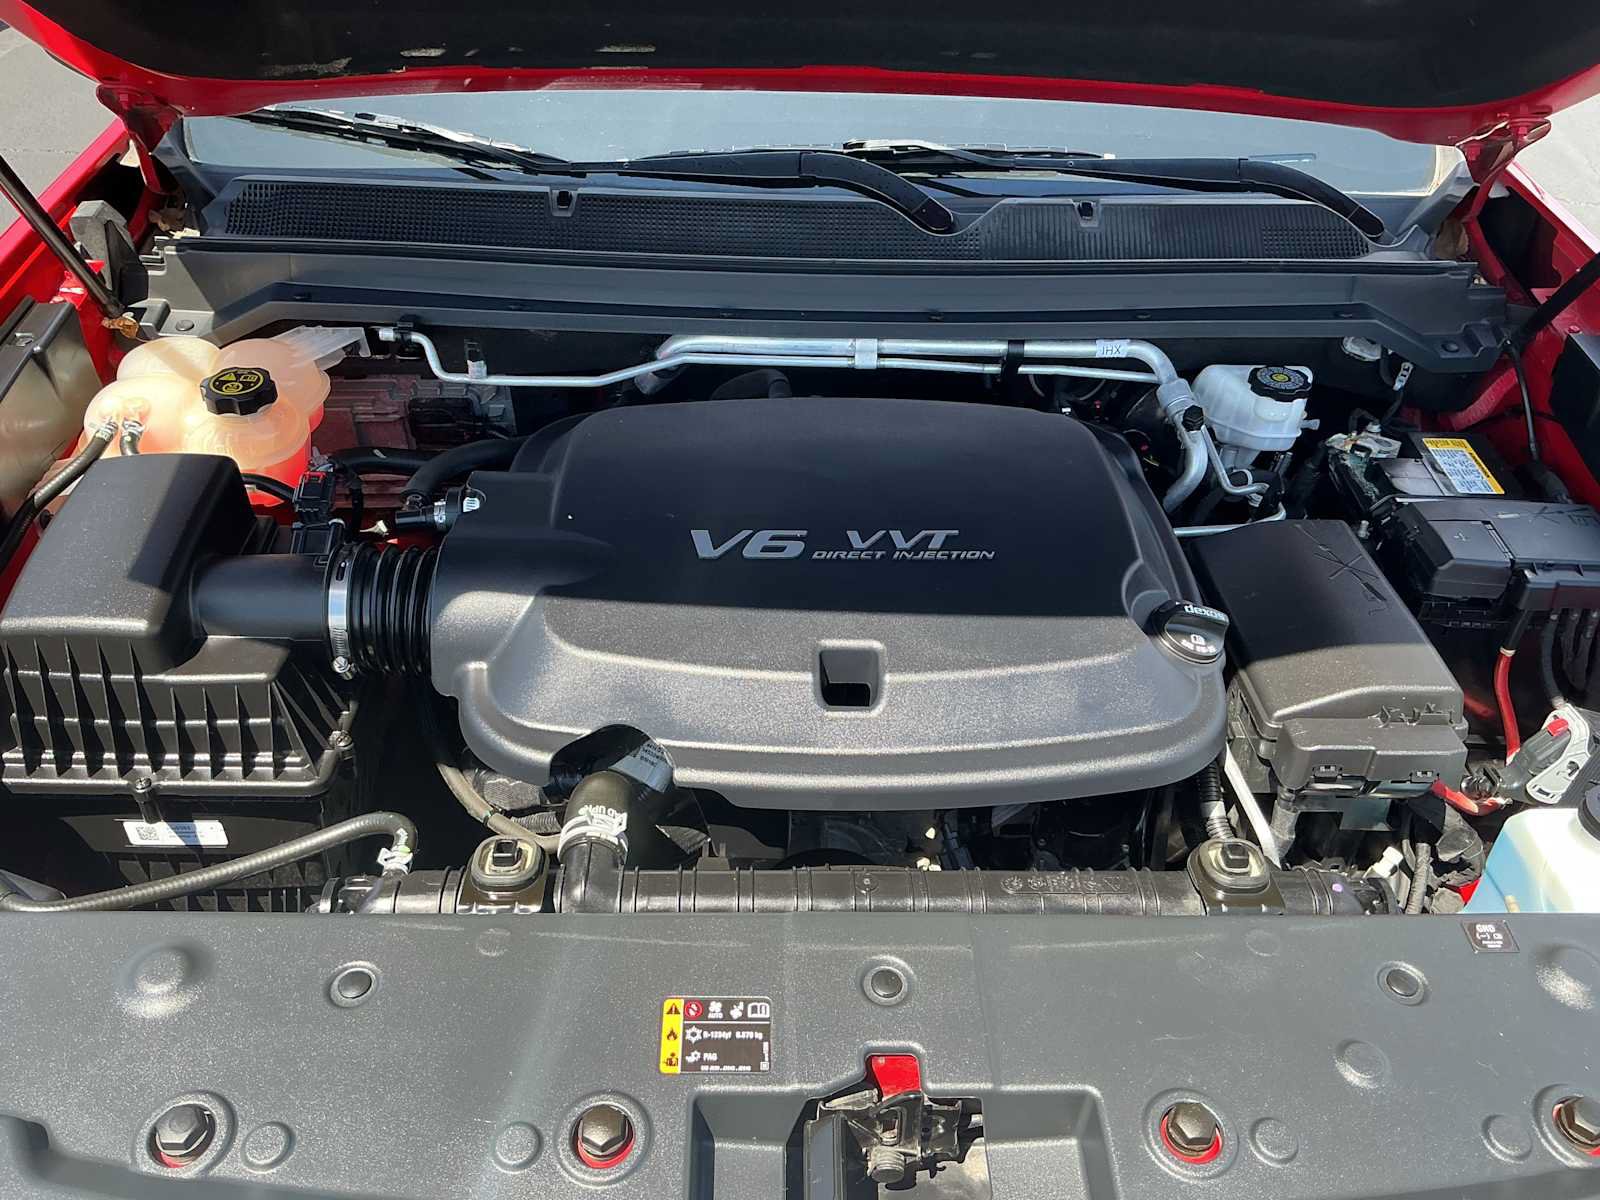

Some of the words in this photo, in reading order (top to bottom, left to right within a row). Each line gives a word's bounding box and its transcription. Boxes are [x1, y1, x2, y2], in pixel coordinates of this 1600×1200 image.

[690, 529, 807, 559] V6
[846, 529, 959, 549] VVT
[812, 550, 885, 560] DIRECT
[892, 550, 995, 560] INJECTION
[1183, 604, 1226, 621] dexos
[703, 1052, 718, 1062] PAG
